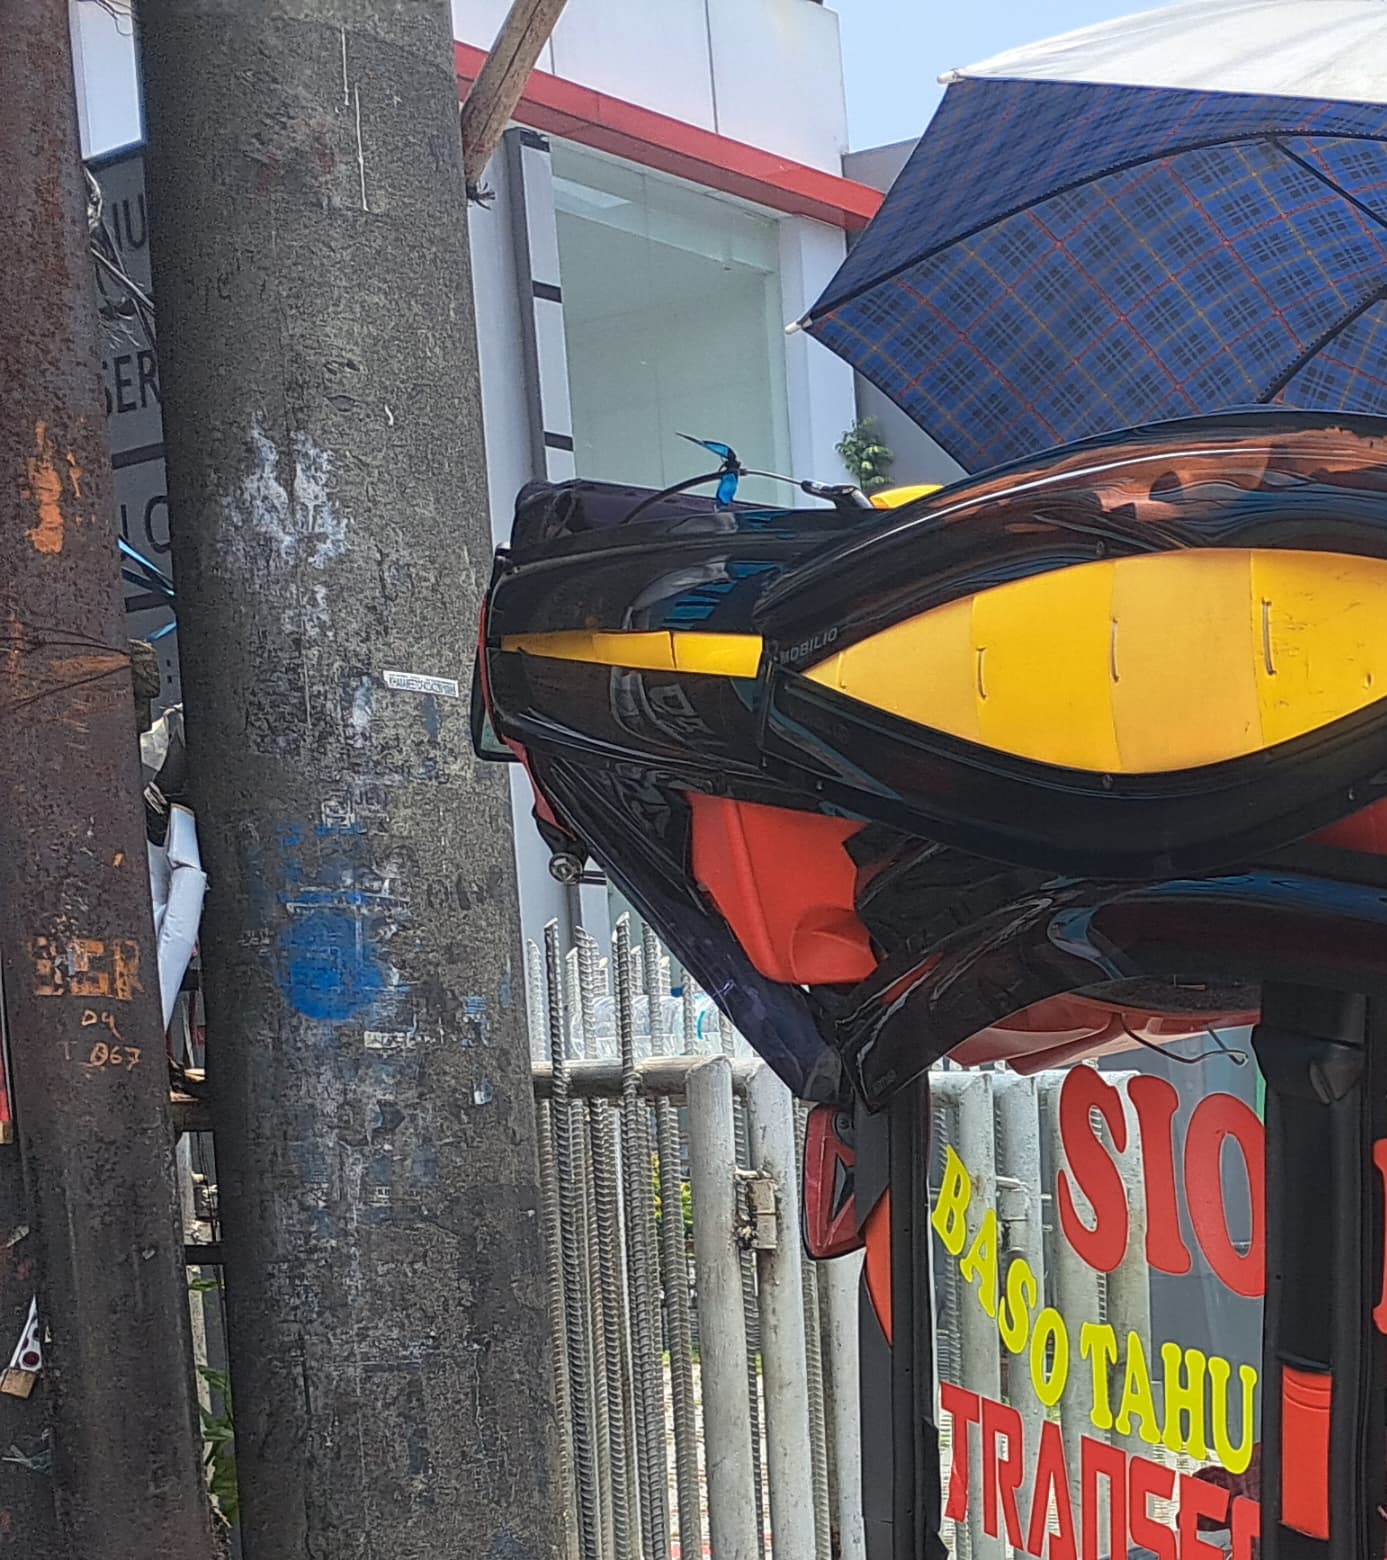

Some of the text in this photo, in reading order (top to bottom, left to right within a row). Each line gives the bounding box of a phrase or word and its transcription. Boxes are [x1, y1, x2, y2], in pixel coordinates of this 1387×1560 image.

[931, 1144, 1259, 1475] BASO TAHU
[1057, 1064, 1266, 1299] SIO
